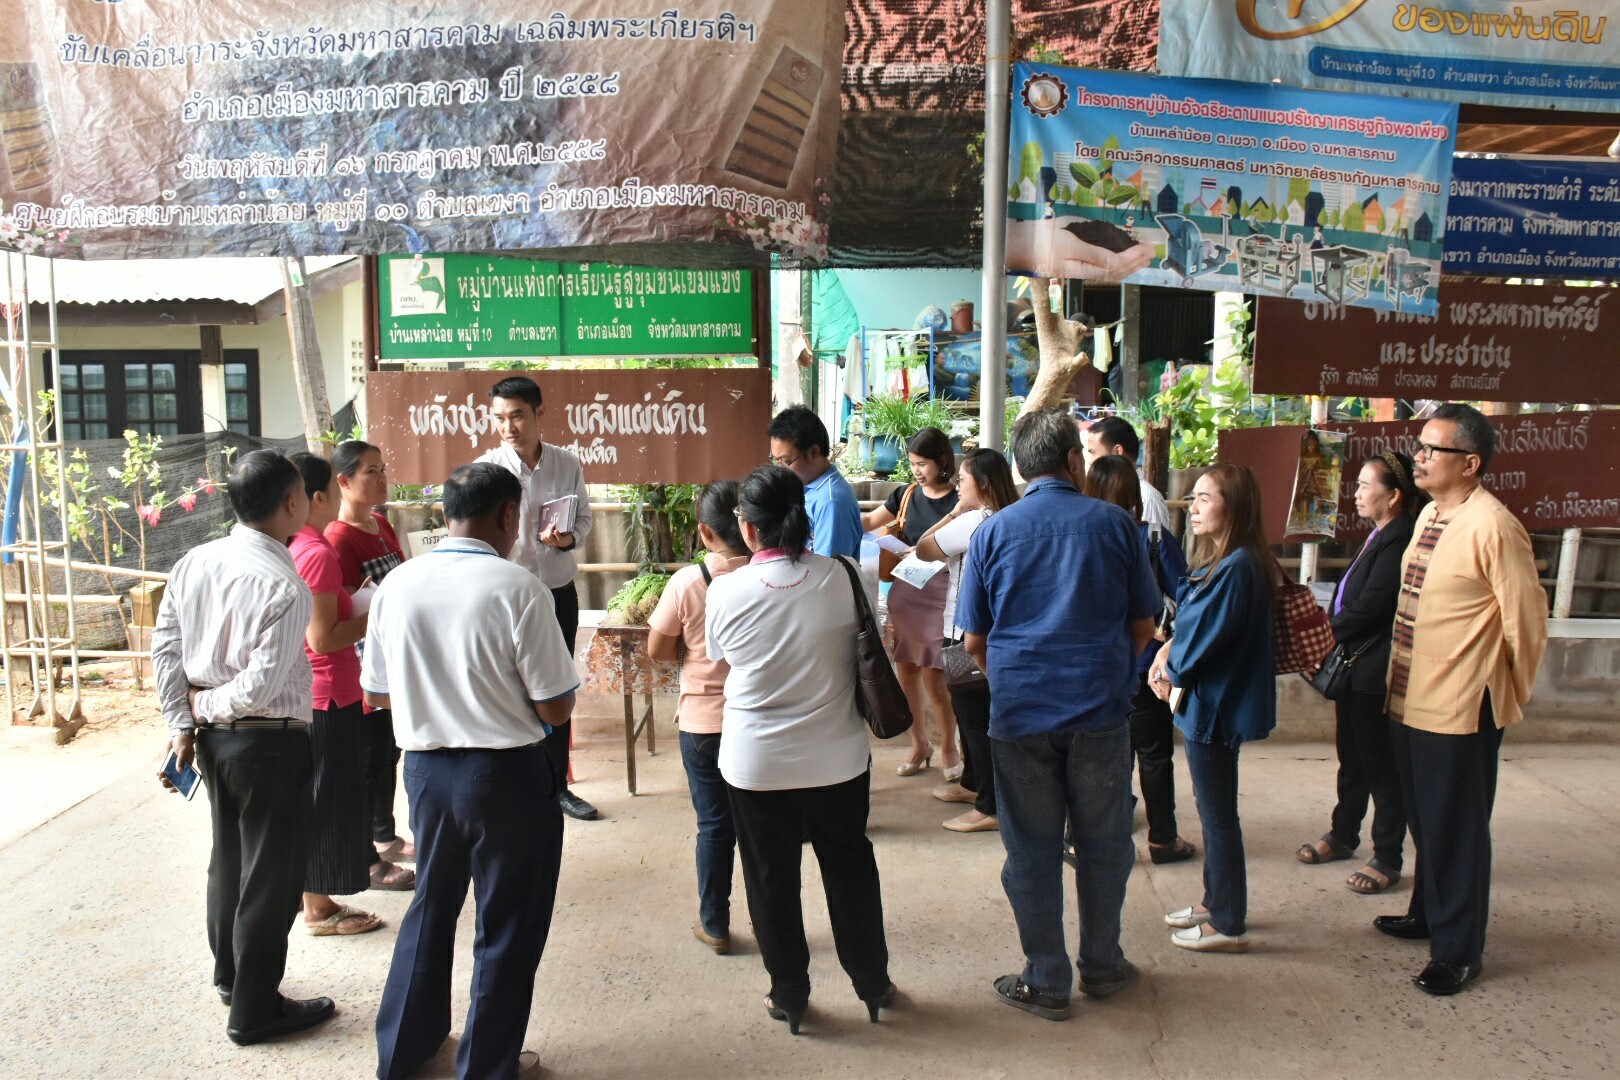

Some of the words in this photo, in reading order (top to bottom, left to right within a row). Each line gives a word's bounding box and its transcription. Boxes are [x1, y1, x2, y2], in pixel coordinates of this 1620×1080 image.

[516, 9, 756, 43] เฉลิมพระเกียรติฯ
[1391, 4, 1608, 45] ของแผ่นดิน
[183, 77, 488, 122] อำเภอเมืองมหาสารคาม
[501, 66, 523, 100] ปี
[535, 73, 619, 98] ๒๕๕๘
[1130, 123, 1212, 144] บ้านเหล่าน้อย
[1216, 134, 1257, 149] ต.เขวา
[1262, 137, 1308, 154] อ.เมือง
[1311, 143, 1397, 163] จ.มหาสารคาม
[178, 144, 328, 183] วันพฤหัสบดีที่
[336, 155, 366, 175] ๑๖
[374, 146, 482, 179] กรกฎาคม
[1075, 142, 1101, 159] โดย
[1105, 148, 1246, 173] คณะวิศวกรรมศาสตร์
[1250, 163, 1441, 195] มหาวิทยาลัยราชภัฏมหาสารคาม
[316, 189, 367, 231] หมู่ที่
[375, 203, 409, 221] ๑๐
[538, 177, 807, 221] อำเภอเมืองมหาสารคาม
[1450, 176, 1583, 201] องมาจากพระราชดำริ
[1446, 215, 1514, 233] หาสารคาม
[390, 322, 453, 343] บ้านเหล่าน้อย
[457, 317, 480, 350] หมู่ที่
[482, 327, 493, 342] 10
[508, 320, 558, 341] ตำบลเขวา
[577, 317, 633, 339] อำเภอเมือง
[648, 317, 742, 339] จังหวัดมหาสารคาม
[1380, 341, 1417, 365] และ
[565, 390, 707, 436] พลังแผ่นดิน
